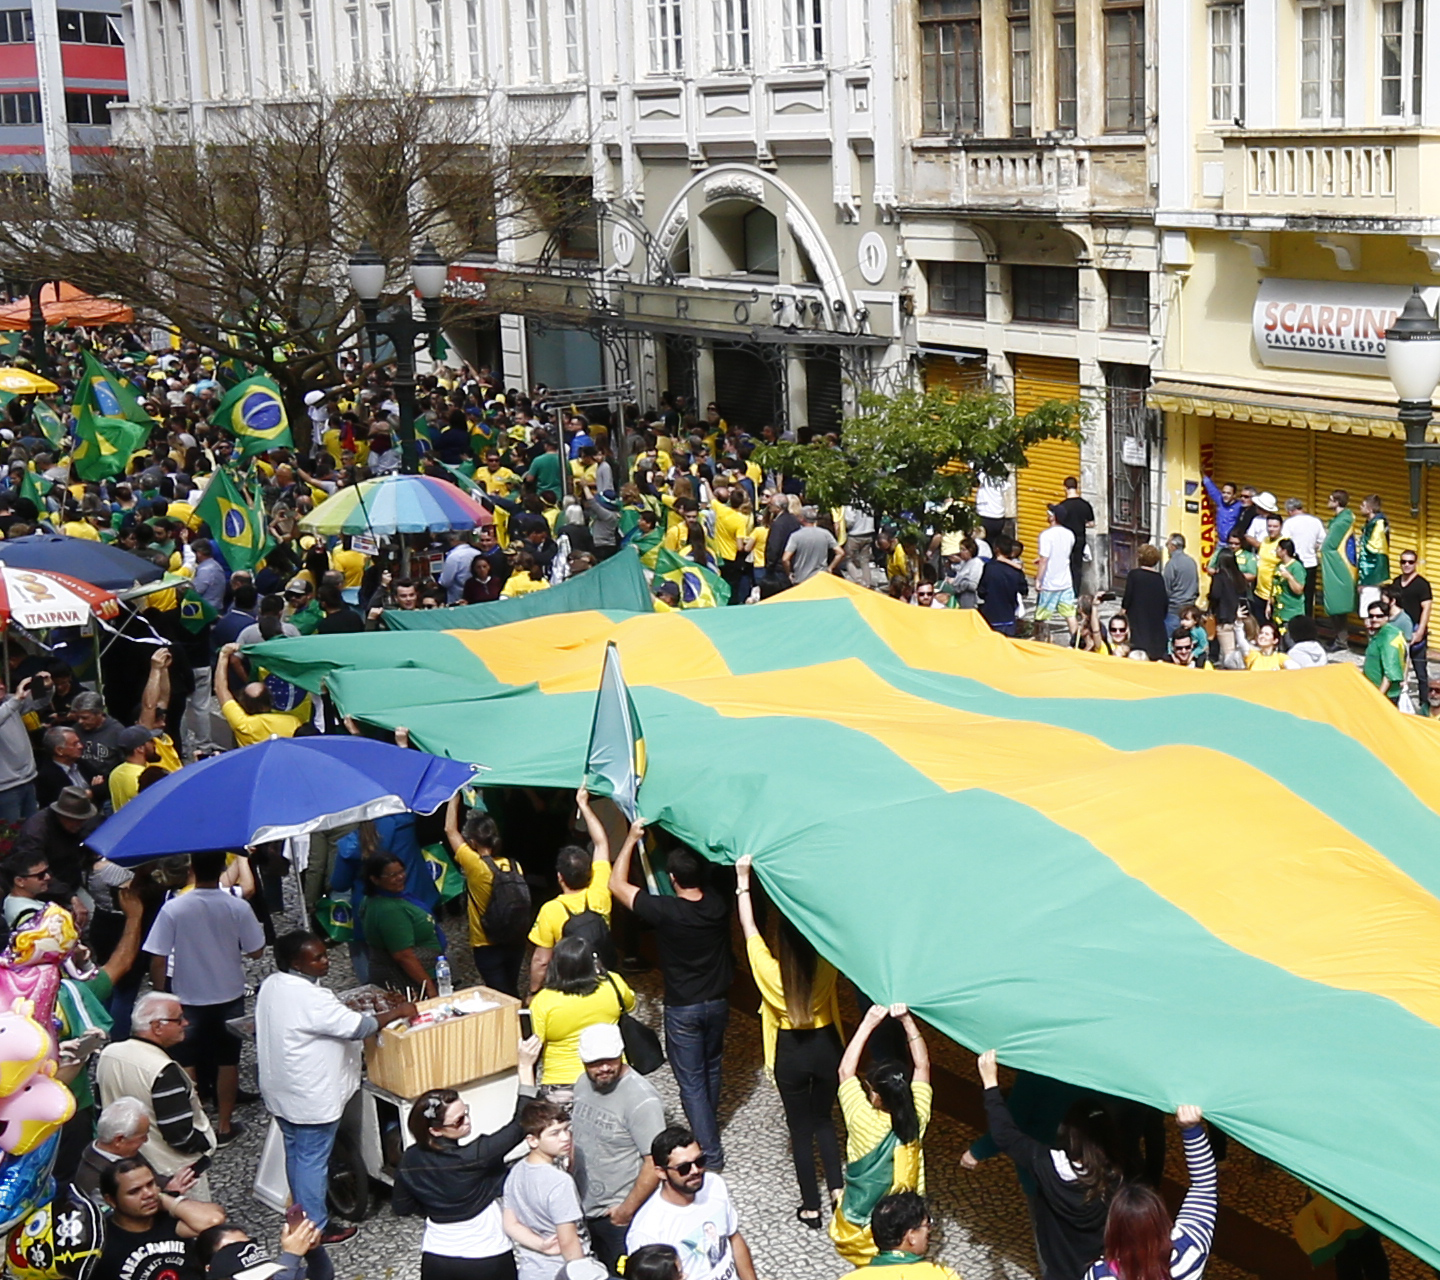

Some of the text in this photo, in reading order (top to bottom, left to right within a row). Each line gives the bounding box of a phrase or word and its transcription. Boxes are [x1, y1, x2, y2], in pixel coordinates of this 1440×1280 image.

[1265, 333, 1335, 349] CALÇADOS
[1340, 338, 1346, 350] E
[25, 611, 83, 627] ITAIPAVA
